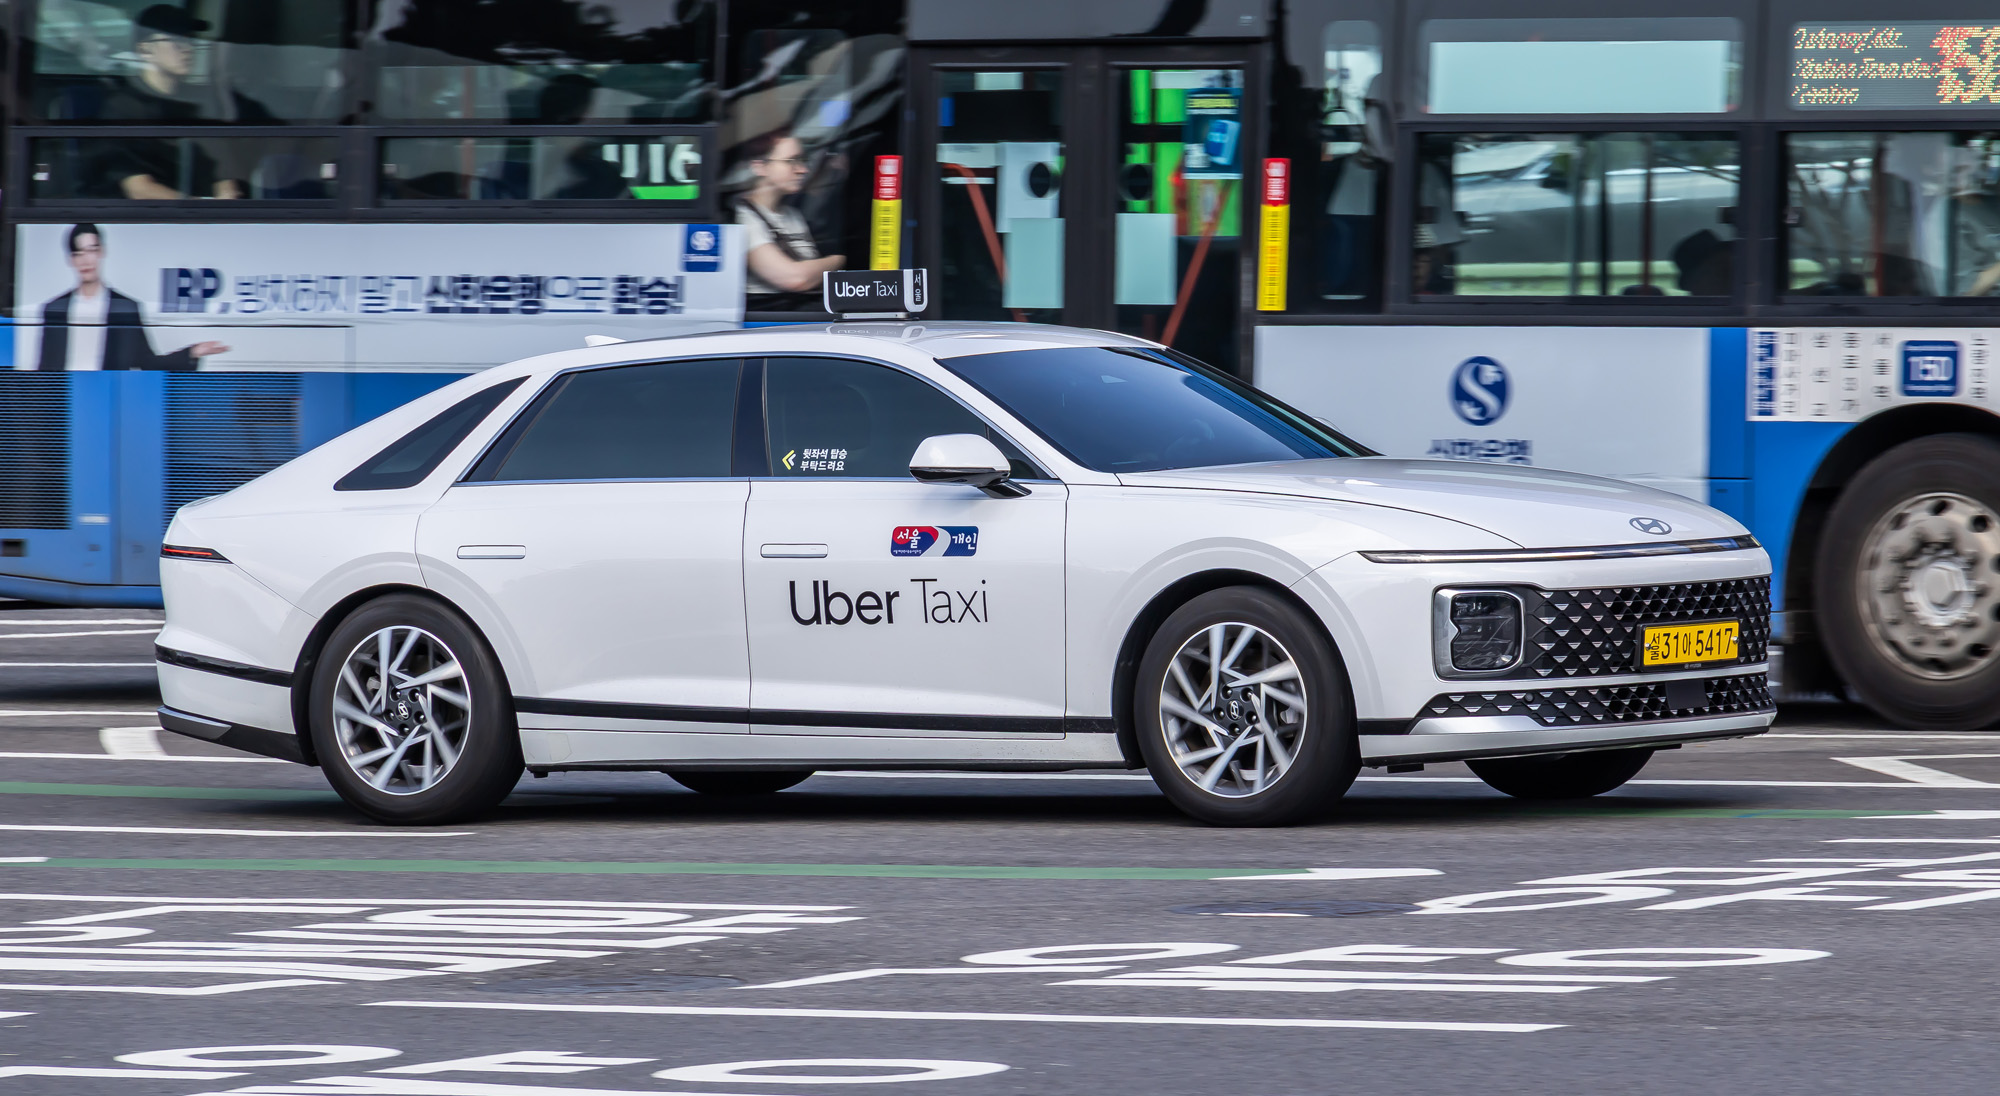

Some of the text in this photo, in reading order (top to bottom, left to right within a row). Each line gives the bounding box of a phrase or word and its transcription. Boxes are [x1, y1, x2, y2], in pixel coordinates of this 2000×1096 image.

[235, 274, 356, 313] 방치하지
[359, 275, 424, 313] 말고
[425, 274, 606, 314] 신한은행으로
[611, 274, 682, 314] 환승!
[834, 281, 898, 297] Uber Taxi
[914, 273, 922, 302] 서울
[800, 461, 844, 471] 부탁드려요
[803, 449, 847, 459] 뒷좌석 탑승
[897, 528, 977, 550] 서울 개인
[789, 578, 988, 626] Uber Taxi
[1651, 627, 1733, 661] 서울 31아 5417
